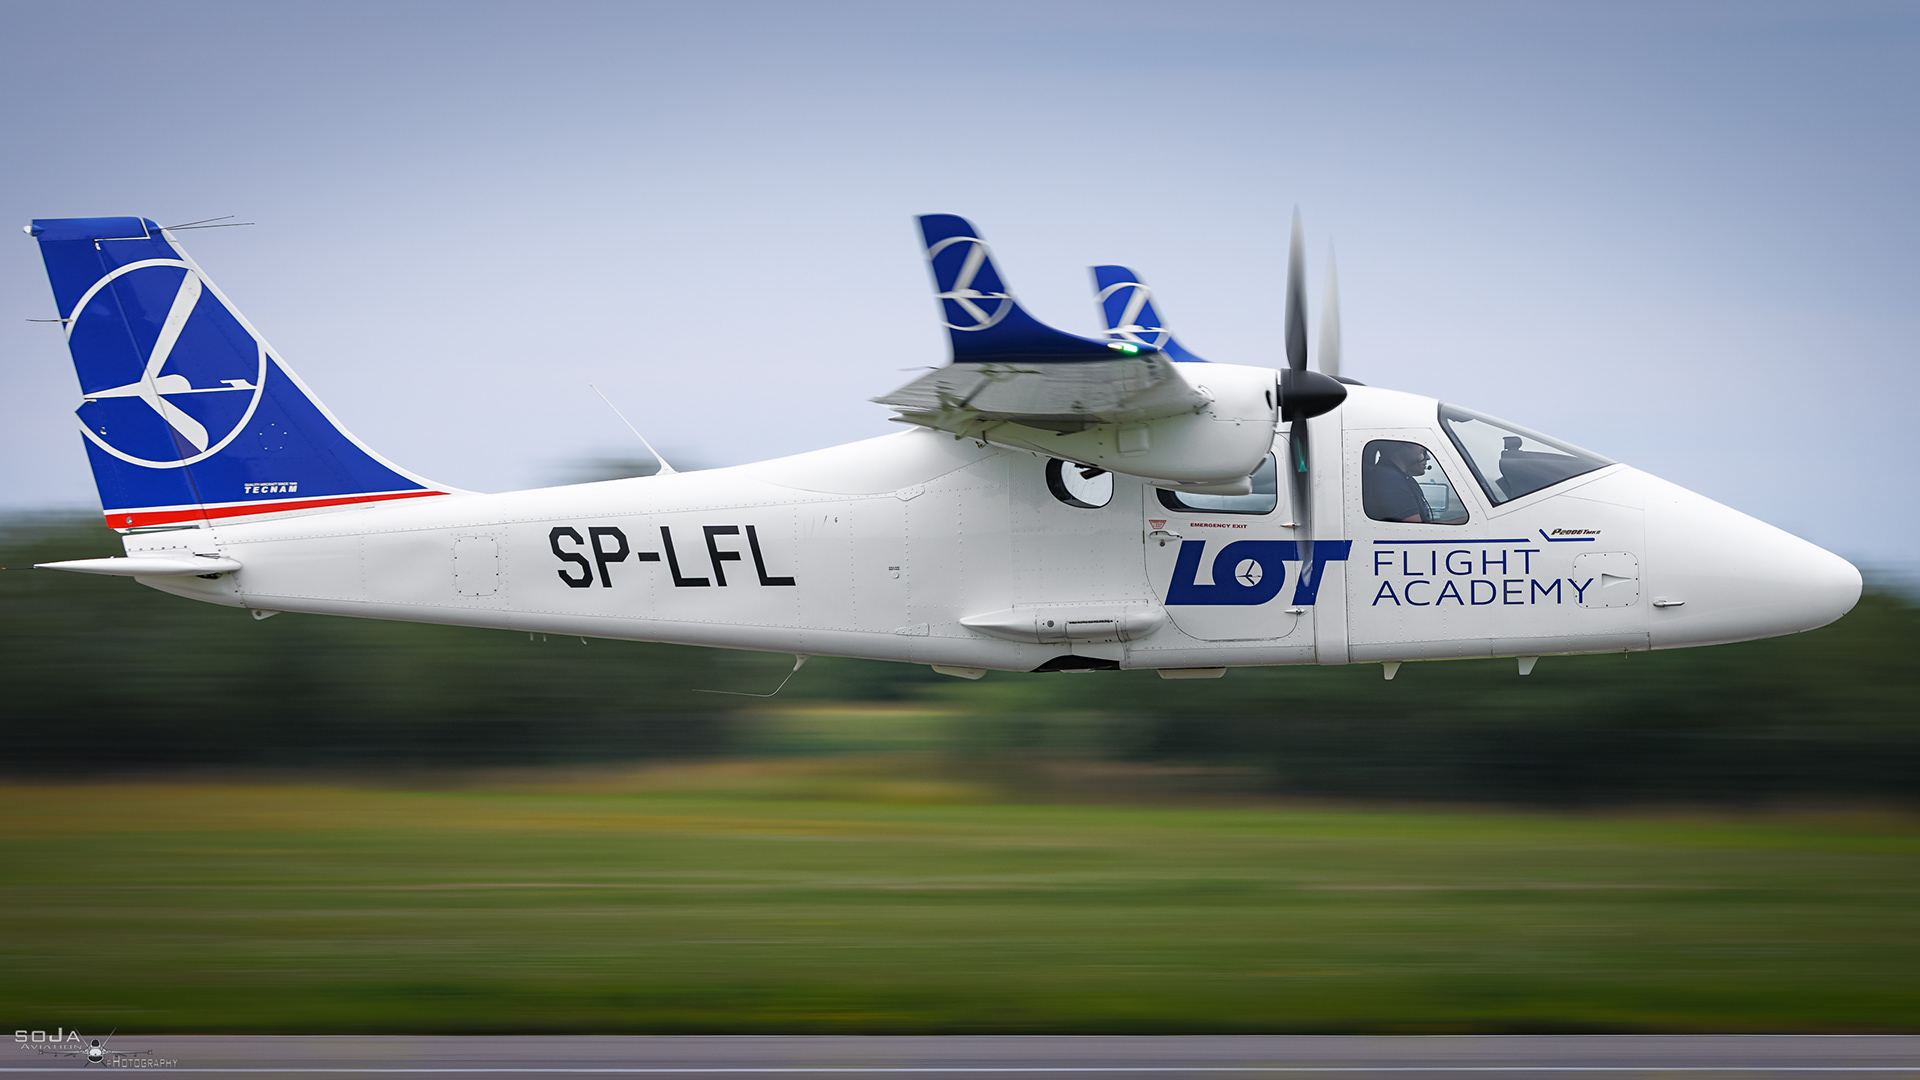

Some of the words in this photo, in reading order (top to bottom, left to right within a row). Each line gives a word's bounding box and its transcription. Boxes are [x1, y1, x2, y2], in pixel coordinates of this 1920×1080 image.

[244, 485, 298, 494] TECNAM
[548, 524, 797, 589] SP-LFL
[1373, 549, 1540, 577] FLIGHT
[1164, 540, 1353, 606] LOT
[1372, 578, 1594, 606] ACADEMY
